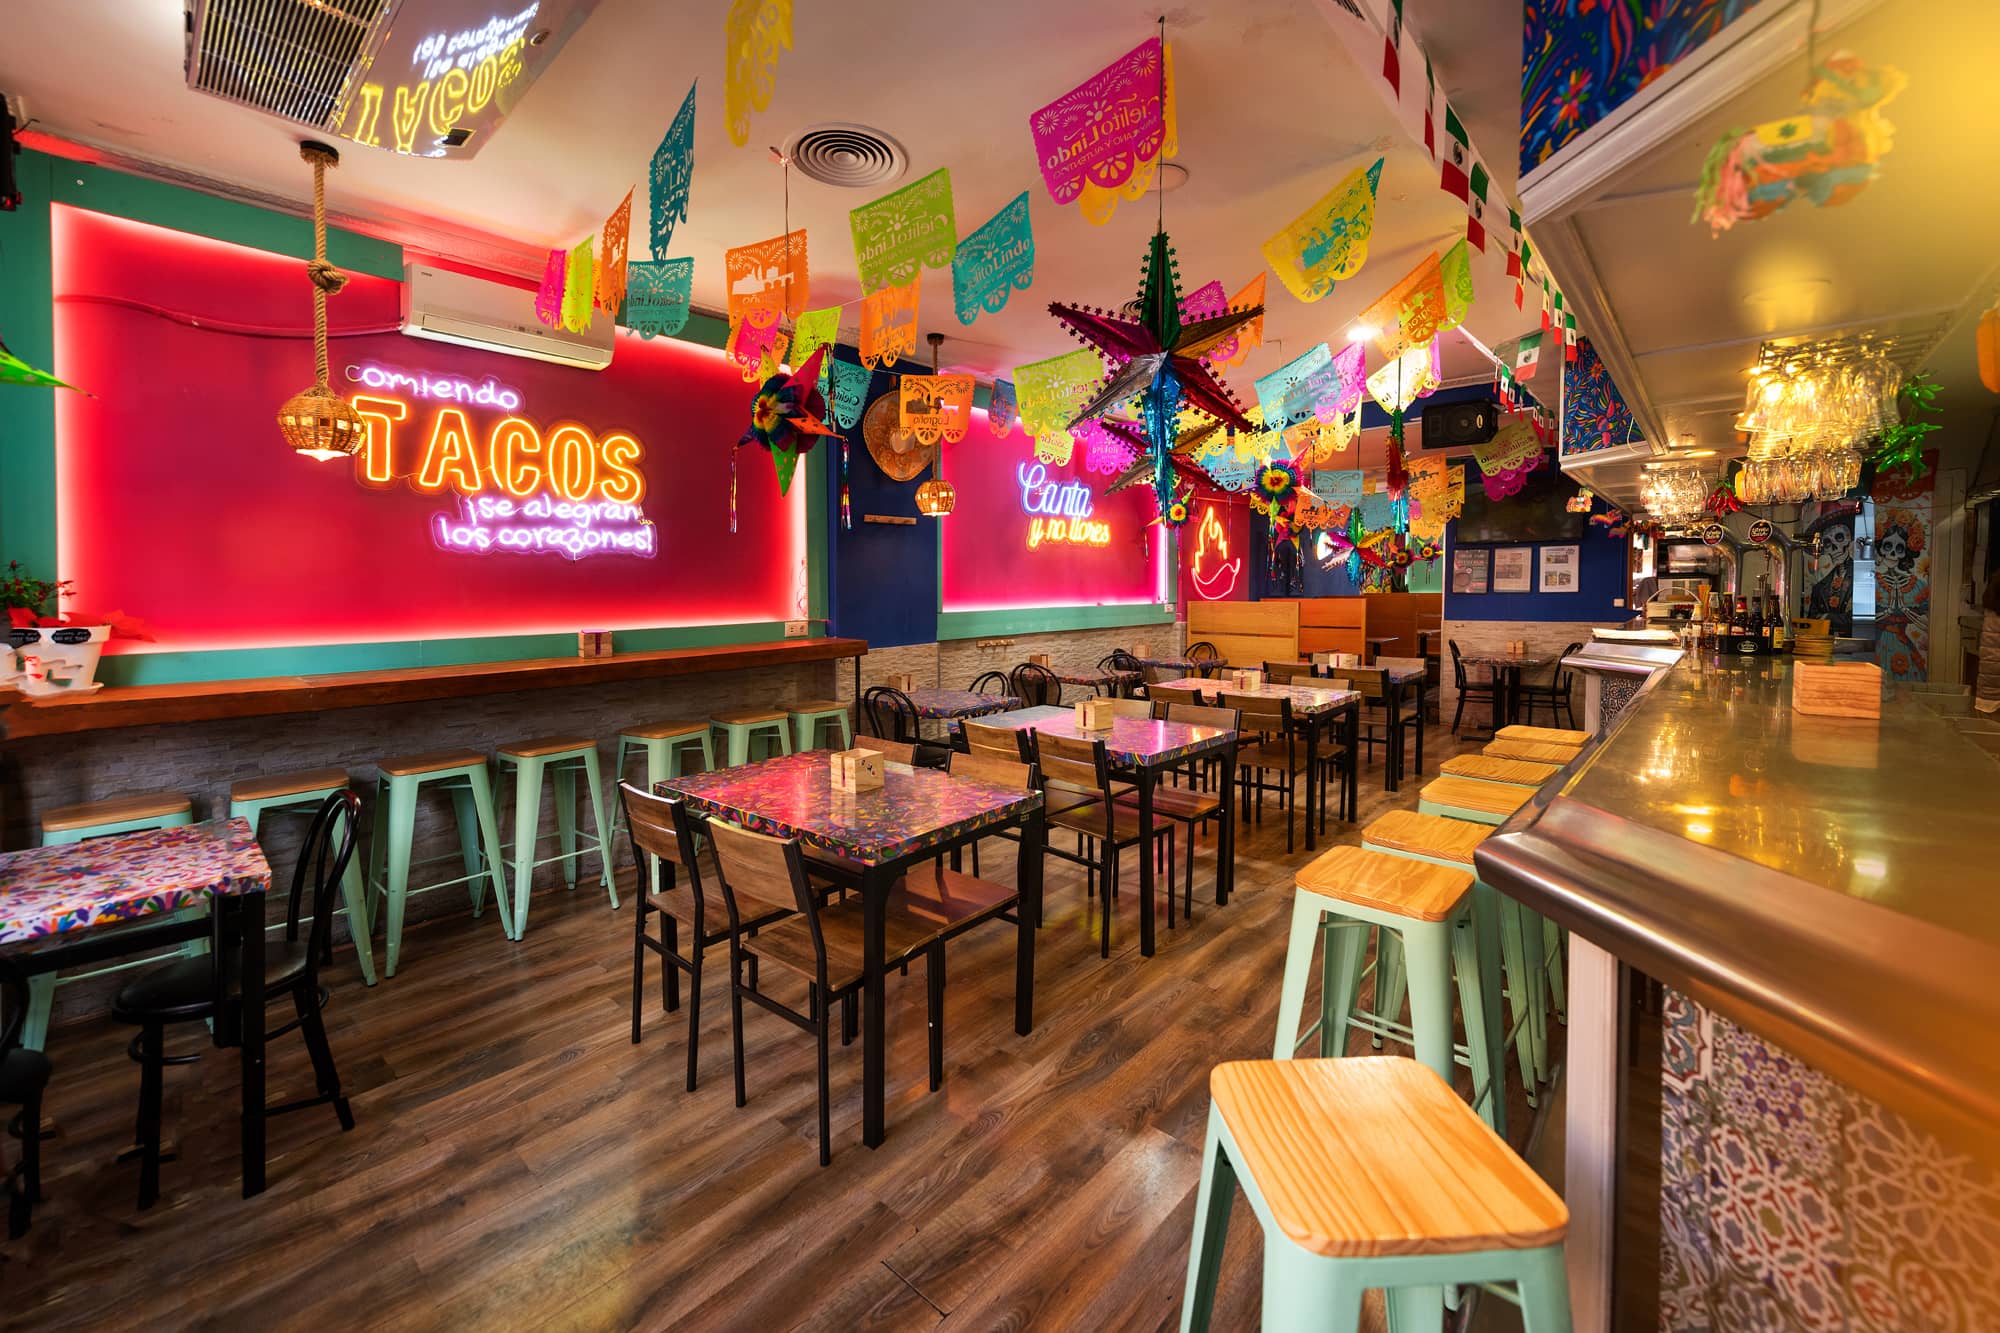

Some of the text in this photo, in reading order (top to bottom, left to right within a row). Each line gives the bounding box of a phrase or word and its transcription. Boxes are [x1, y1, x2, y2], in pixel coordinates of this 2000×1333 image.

[352, 395, 642, 503] TACOS
[1018, 461, 1094, 518] Canta
[523, 493, 640, 529] alegran
[439, 517, 654, 552] los corazones!
[1028, 516, 1111, 548] y no llores
